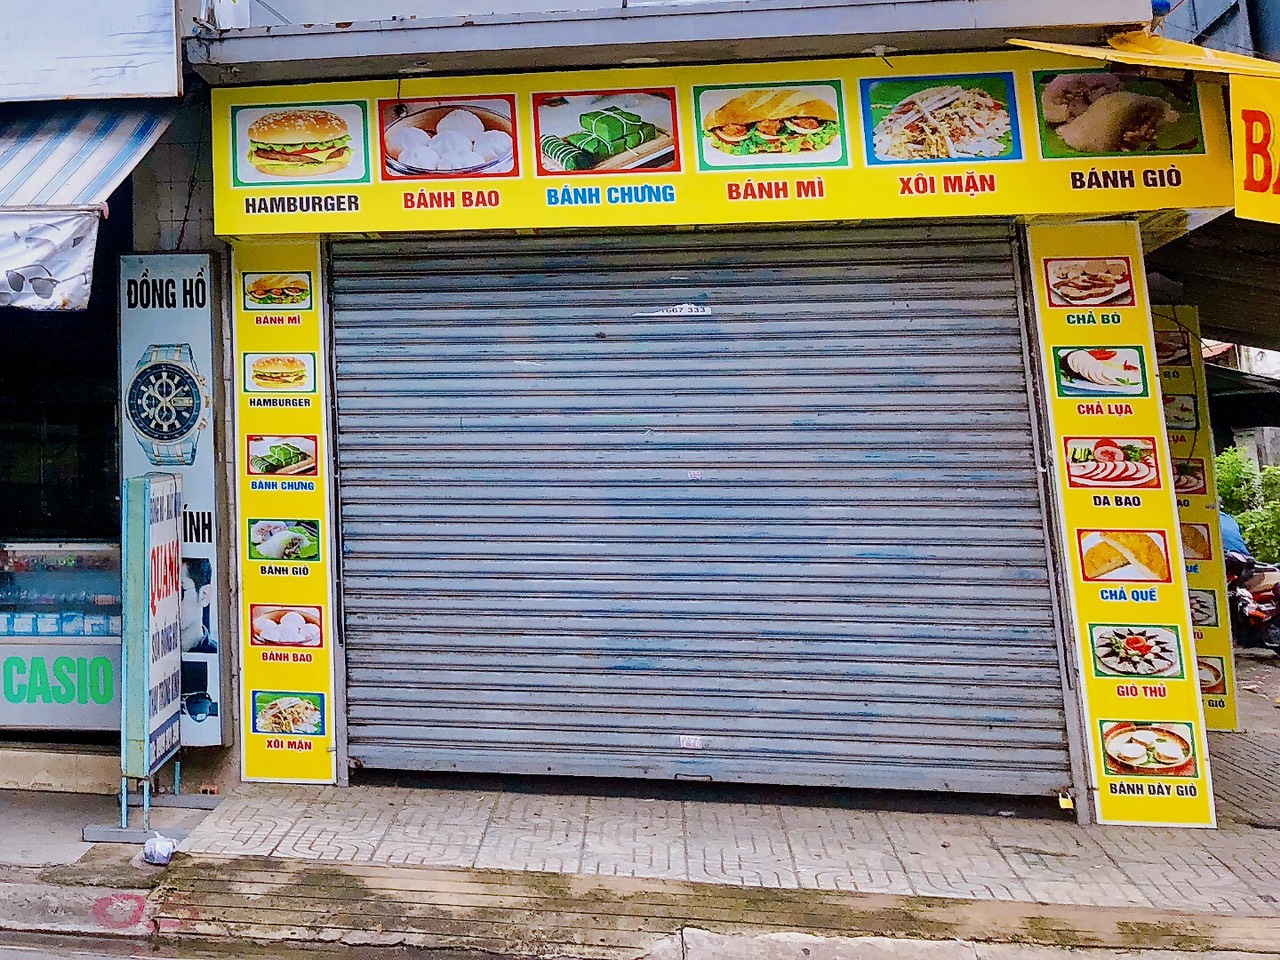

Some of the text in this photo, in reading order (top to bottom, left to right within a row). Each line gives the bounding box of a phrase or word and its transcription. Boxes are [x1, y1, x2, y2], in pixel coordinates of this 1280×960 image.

[1240, 108, 1280, 195] B
[898, 171, 996, 197] XÔI MẶN
[1070, 164, 1183, 190] BÁNH GIÒ
[546, 183, 676, 206] BÁNH CHƯNG
[726, 176, 825, 200] BÁNH MÌ
[244, 195, 360, 214] HAMBURGER
[403, 188, 500, 209] BÁNH BAO
[126, 267, 207, 309] ĐỒNG HỒ
[255, 314, 301, 325] BÁNH MÌ
[1066, 310, 1121, 325] CHẢ BÒ
[249, 397, 311, 408] HAMBURGER
[1077, 401, 1134, 418] CHẢ LỤA
[251, 478, 315, 491] BÁNH CHƯNG
[1093, 495, 1142, 507] DA BAO
[1177, 498, 1190, 508] AO
[183, 503, 213, 544] ÍNH
[260, 564, 310, 576] BÁNH GIÒ
[150, 539, 180, 618] QUANG
[1100, 586, 1158, 602] CHẢ QUẾ
[261, 650, 313, 663] BÁNH BAO
[2, 655, 115, 705] CASIO
[1116, 683, 1167, 698] GIÒ THỦ
[266, 738, 312, 752] XÔI MẶN
[1109, 782, 1198, 798] BÁNH DÀY GIÒ
